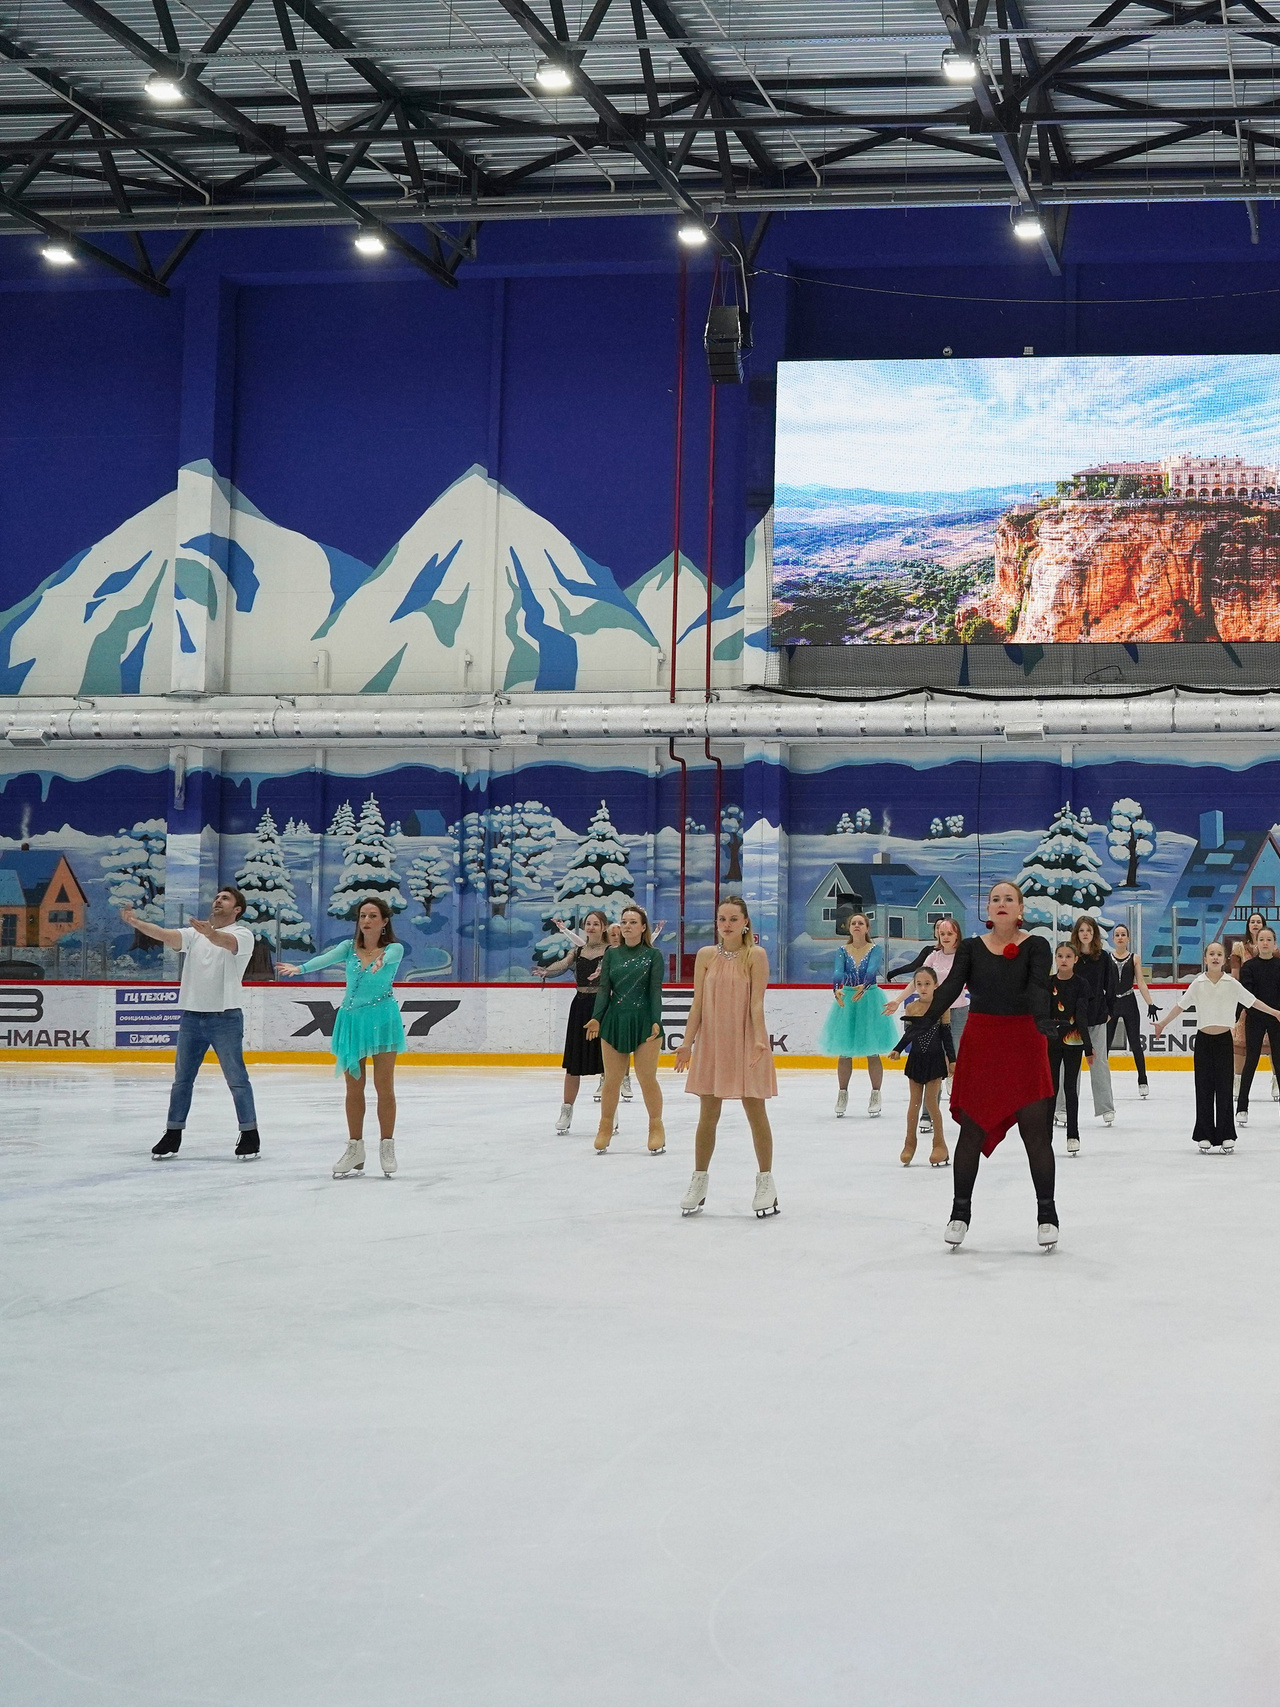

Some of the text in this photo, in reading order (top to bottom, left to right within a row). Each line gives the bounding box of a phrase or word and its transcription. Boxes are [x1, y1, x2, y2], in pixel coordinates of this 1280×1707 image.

[124, 992, 177, 1003] ГЦ ТЕХНО
[119, 1014, 181, 1022] ОФИЦИАЛЬНЫЙ ДИЛЕР
